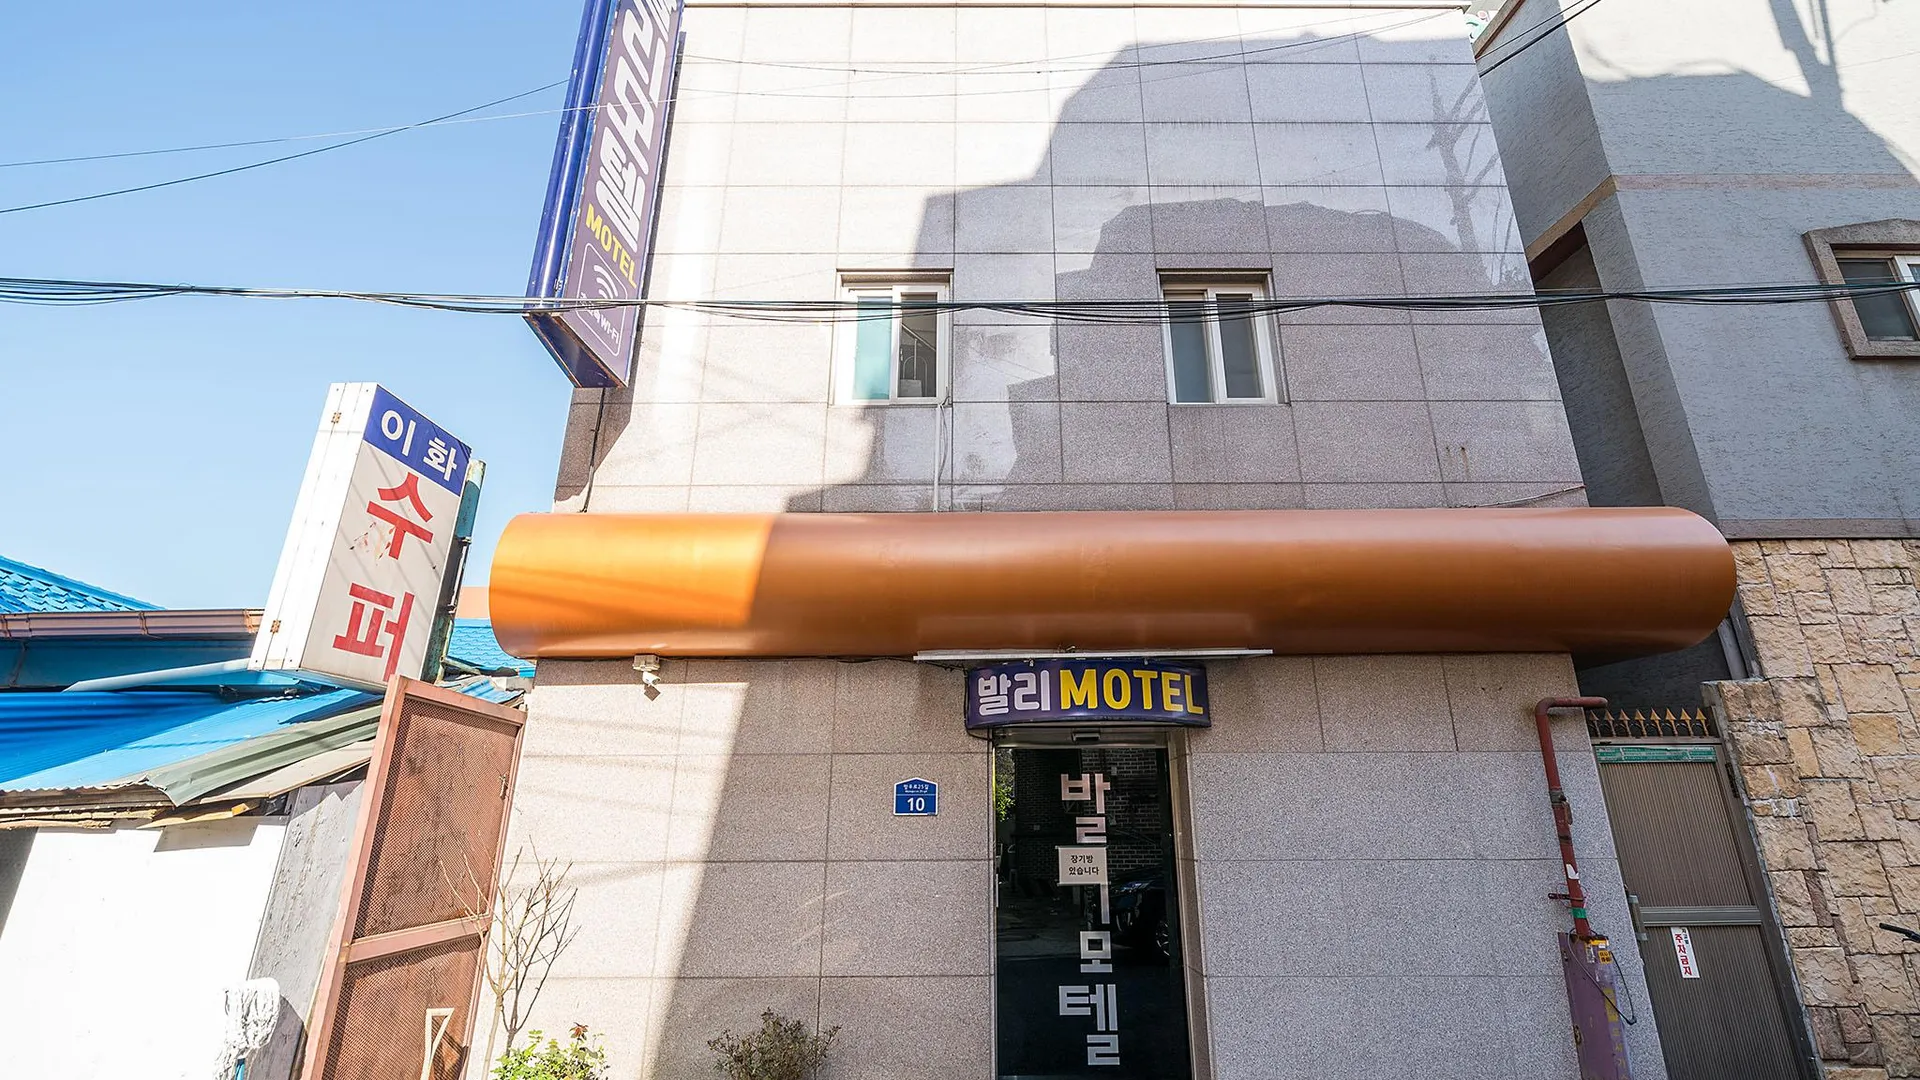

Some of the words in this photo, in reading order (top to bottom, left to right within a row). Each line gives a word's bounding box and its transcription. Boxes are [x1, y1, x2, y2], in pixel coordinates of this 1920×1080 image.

[585, 203, 638, 288] MOTEL
[978, 670, 1050, 716] 발리
[1059, 668, 1204, 715] MOTEL
[907, 797, 925, 811] 10
[1070, 854, 1094, 864] 장기방
[1068, 866, 1100, 876] 있습니다
